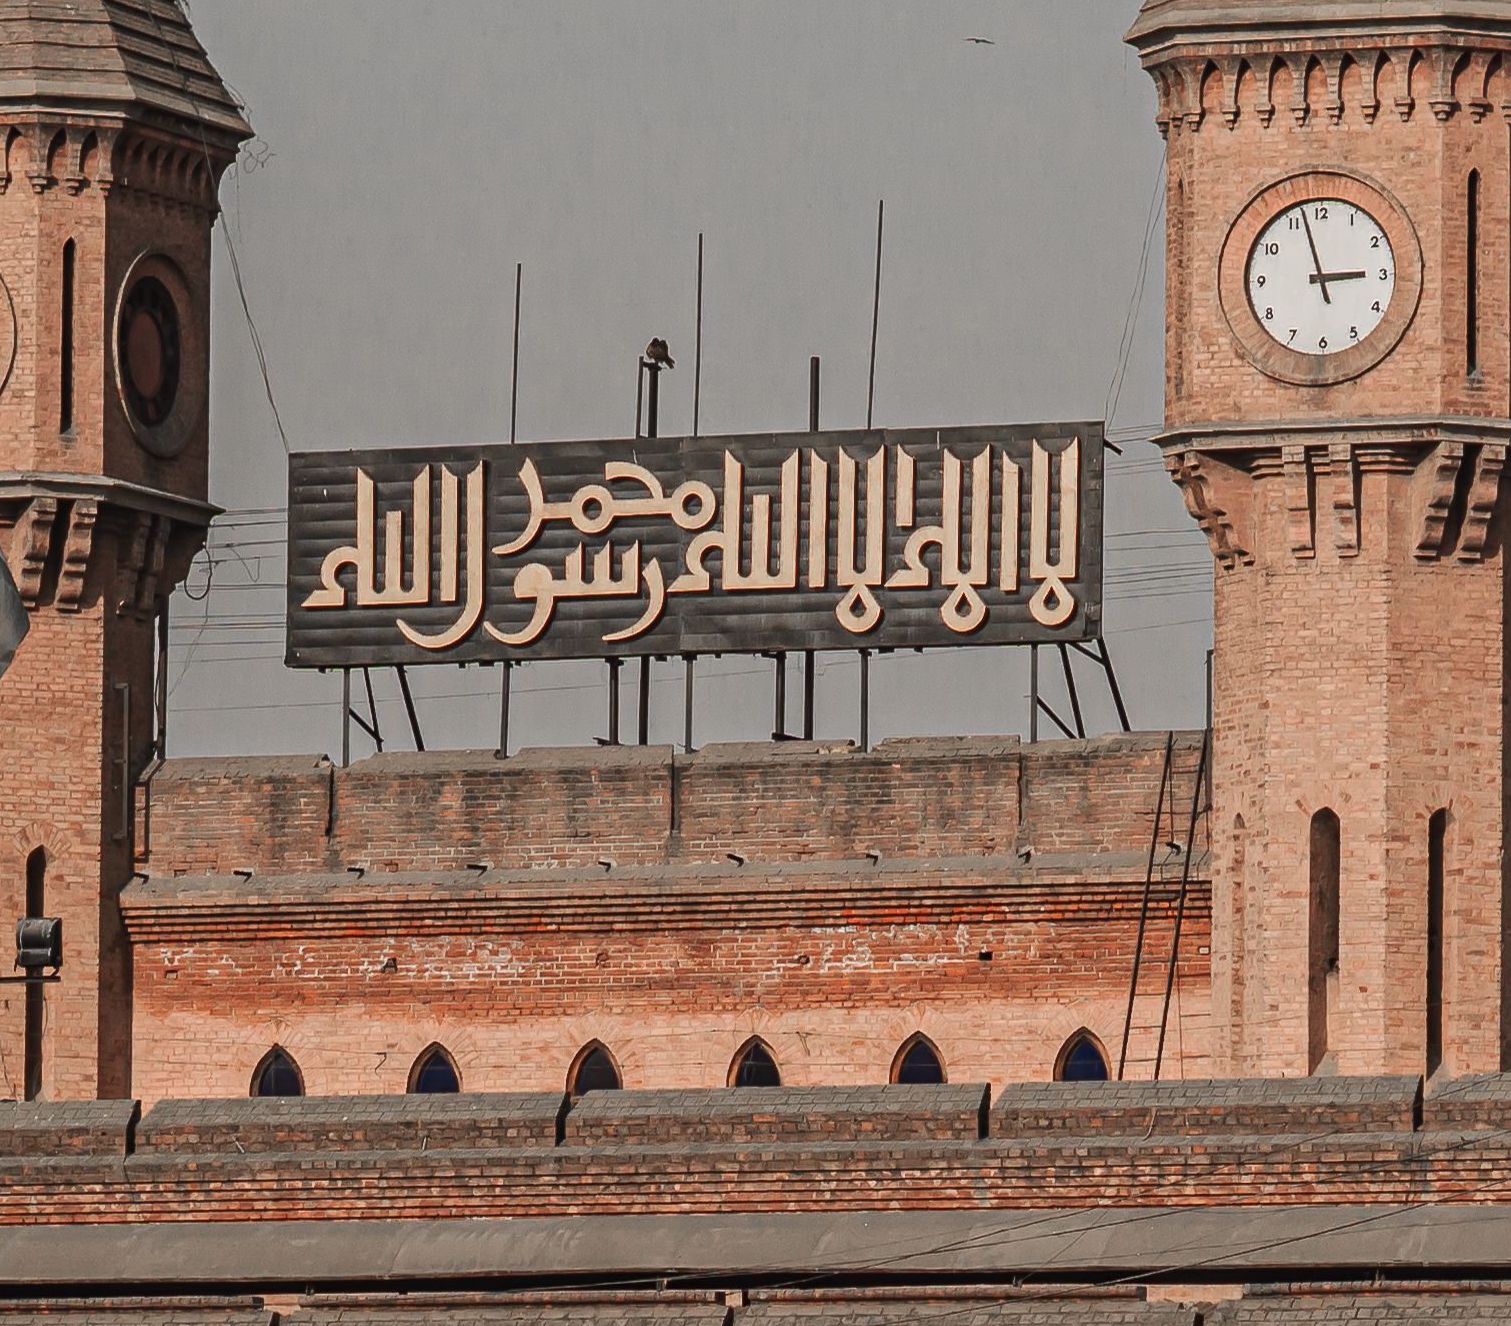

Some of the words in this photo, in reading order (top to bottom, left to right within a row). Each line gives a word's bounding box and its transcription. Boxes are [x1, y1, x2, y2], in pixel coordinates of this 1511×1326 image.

[1315, 207, 1328, 220] 12
[1289, 217, 1299, 230] 11
[1370, 236, 1379, 248] 2
[1265, 243, 1279, 255] 10
[1379, 268, 1388, 281] 3
[1257, 275, 1266, 288] 9
[1265, 307, 1273, 320] 8
[1371, 301, 1381, 313] 4
[1289, 329, 1297, 341] 7
[1349, 326, 1357, 339] 5
[1318, 336, 1328, 349] 6
